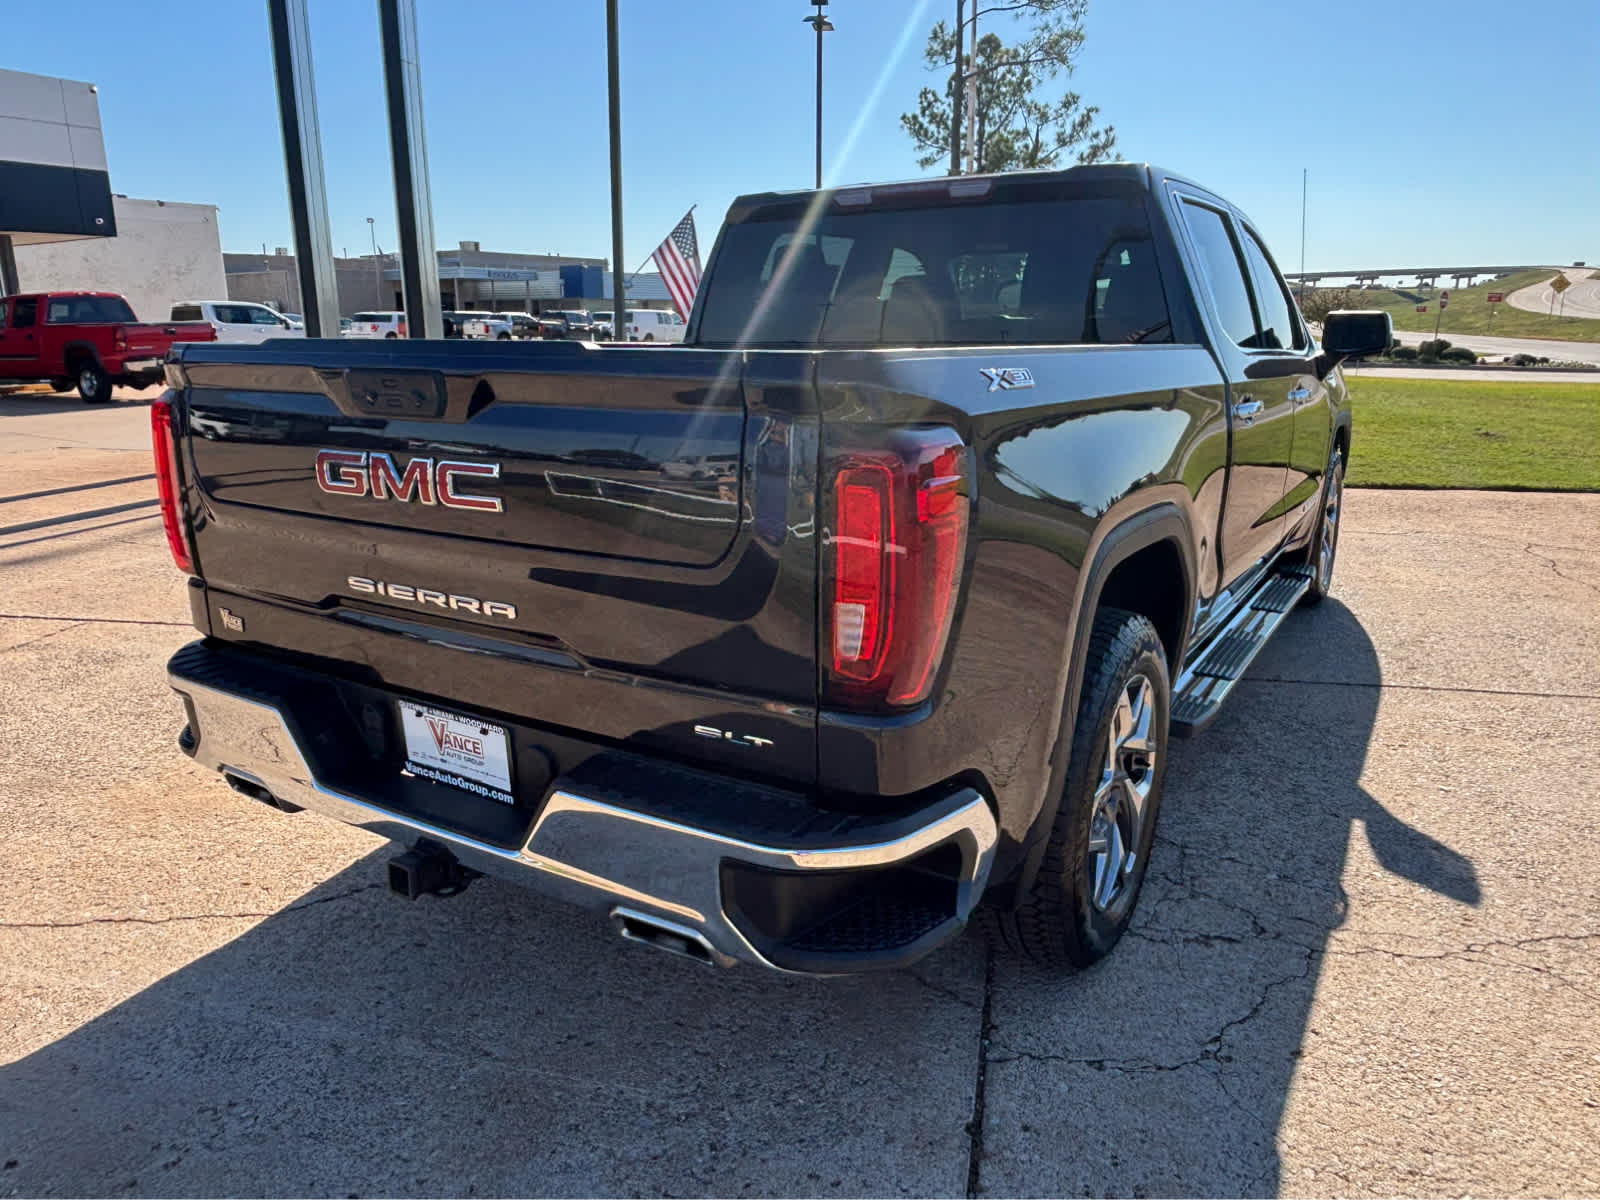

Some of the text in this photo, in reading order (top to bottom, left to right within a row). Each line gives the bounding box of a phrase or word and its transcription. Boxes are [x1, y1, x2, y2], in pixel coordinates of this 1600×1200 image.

[315, 448, 503, 513] GMC
[347, 575, 518, 619] SIERRA
[694, 725, 774, 747] SLT
[404, 760, 515, 806] VanceAutoGroup.com
